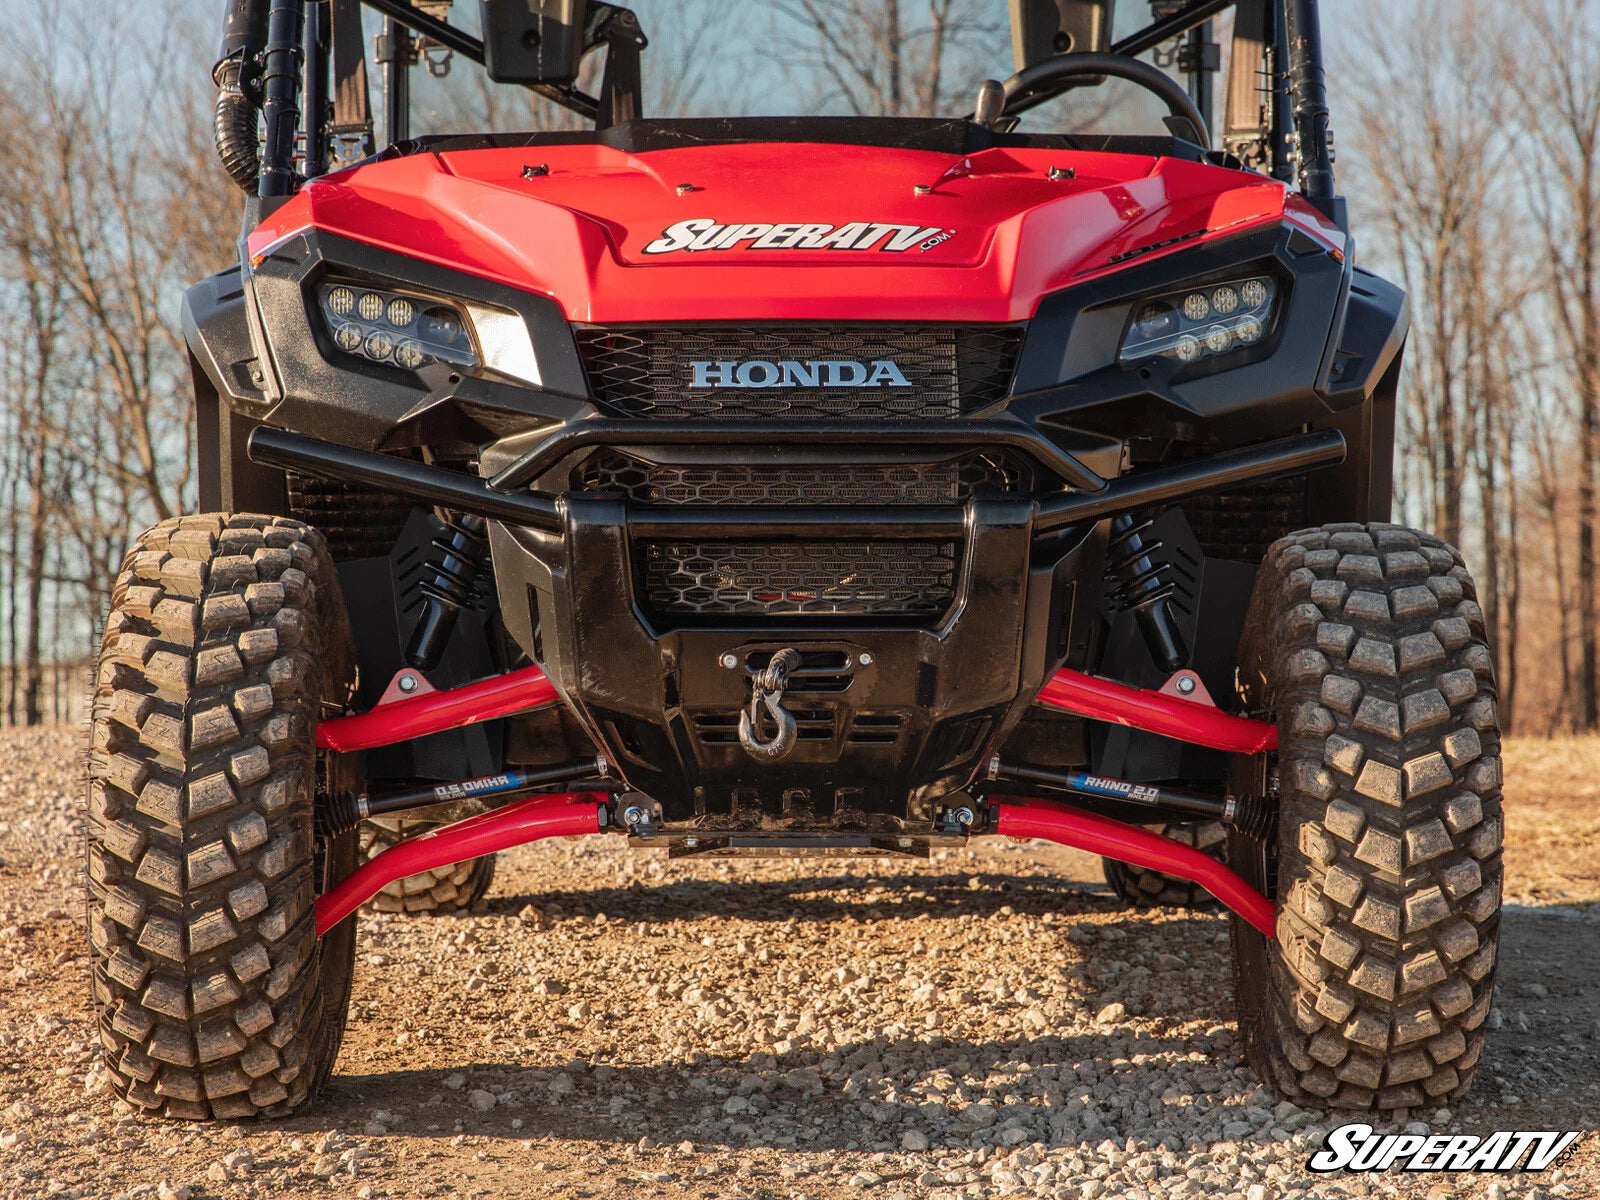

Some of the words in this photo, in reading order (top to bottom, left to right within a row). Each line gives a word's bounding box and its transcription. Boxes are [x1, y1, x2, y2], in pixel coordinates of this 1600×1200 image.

[641, 218, 943, 254] SUPERATV
[689, 360, 912, 388] HONDA
[1084, 776, 1132, 793] RHINO
[1133, 785, 1159, 797] 2.0
